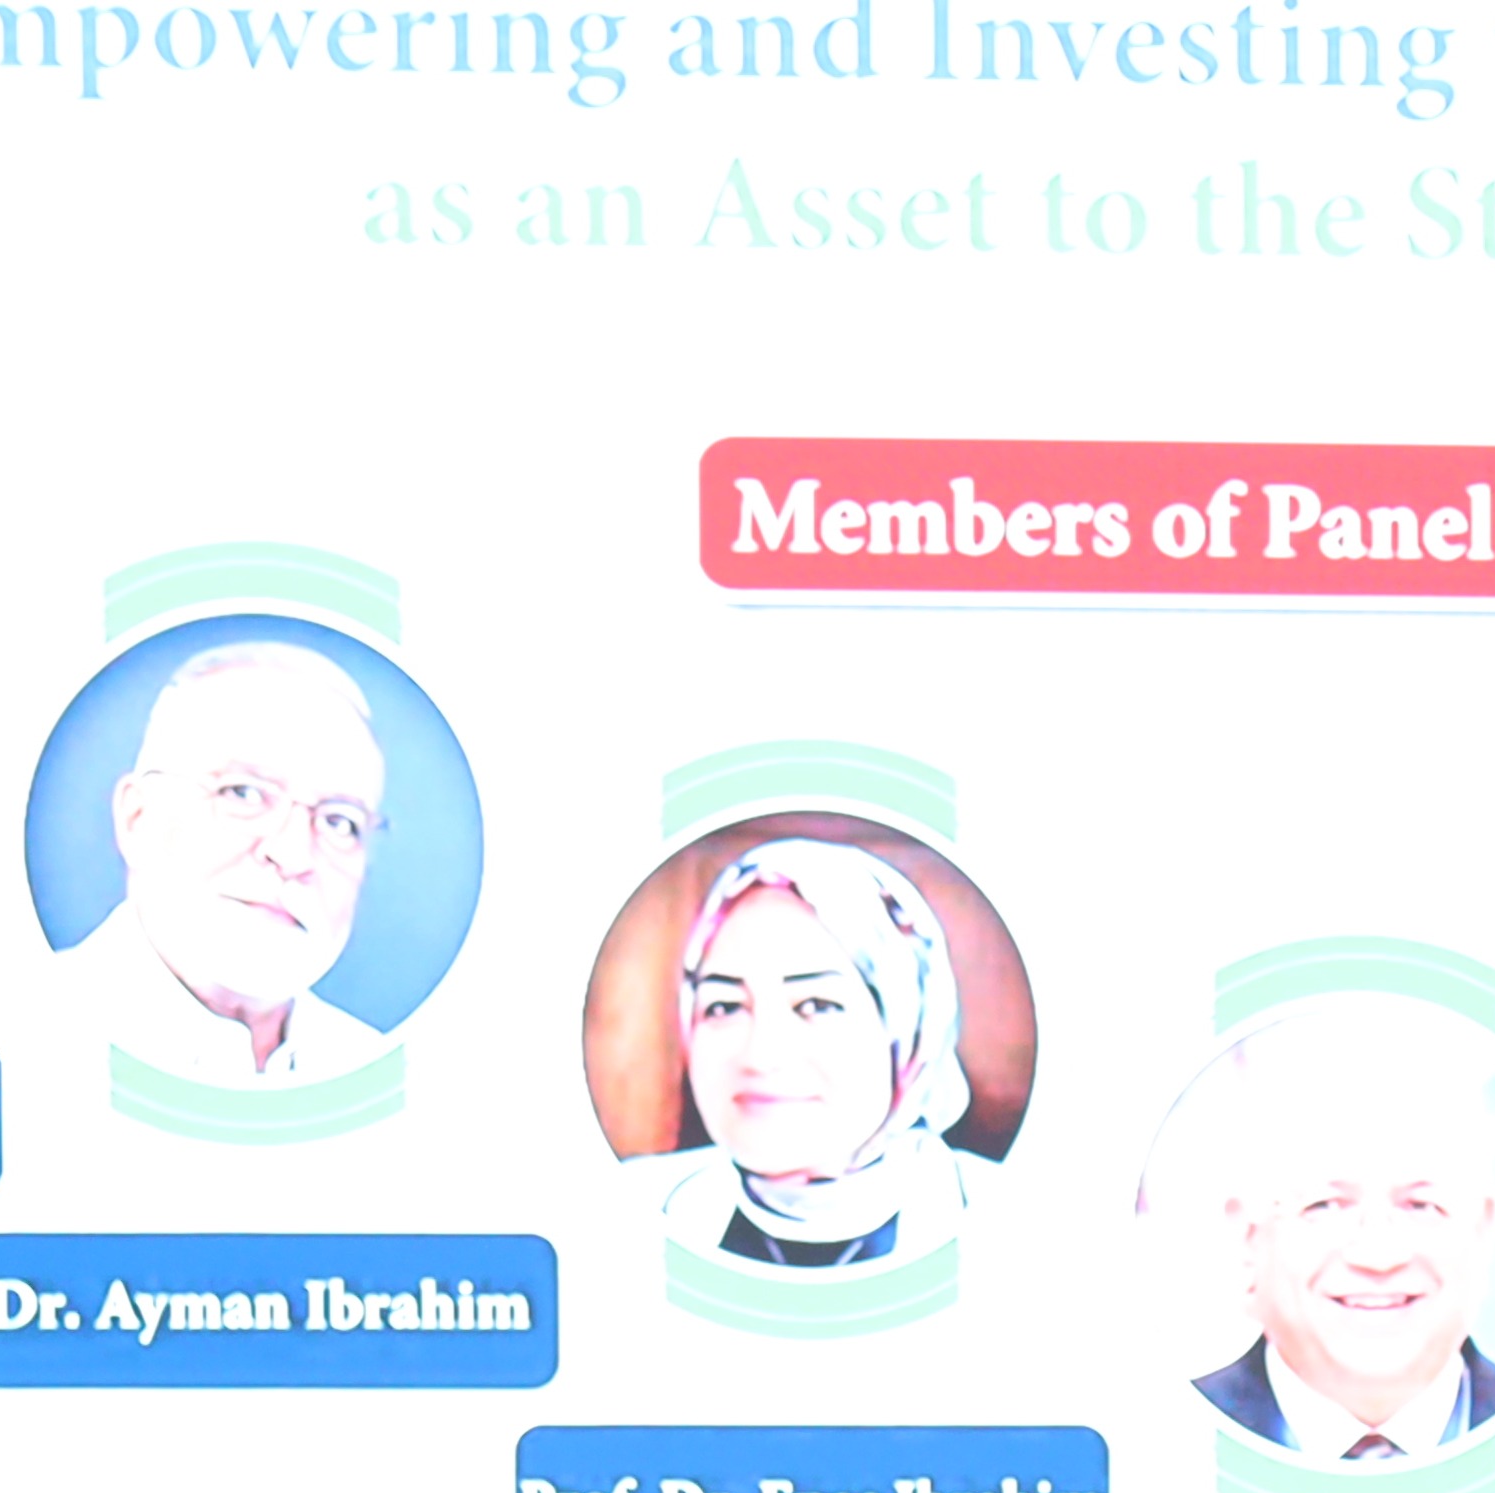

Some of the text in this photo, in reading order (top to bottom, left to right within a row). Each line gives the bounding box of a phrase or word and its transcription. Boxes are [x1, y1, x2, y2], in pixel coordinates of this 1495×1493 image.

[666, 0, 880, 81] and
[922, 0, 1457, 123] Investing
[361, 179, 476, 247] as
[514, 182, 649, 248] an
[691, 155, 999, 254] Asset
[1039, 171, 1151, 257] to
[1189, 158, 1368, 260] the
[730, 476, 1132, 558] Members
[1151, 478, 1249, 559] of
[1262, 483, 1495, 562] Panel
[95, 1280, 290, 1346] Ayman
[305, 1277, 531, 1331] Ibrahim
